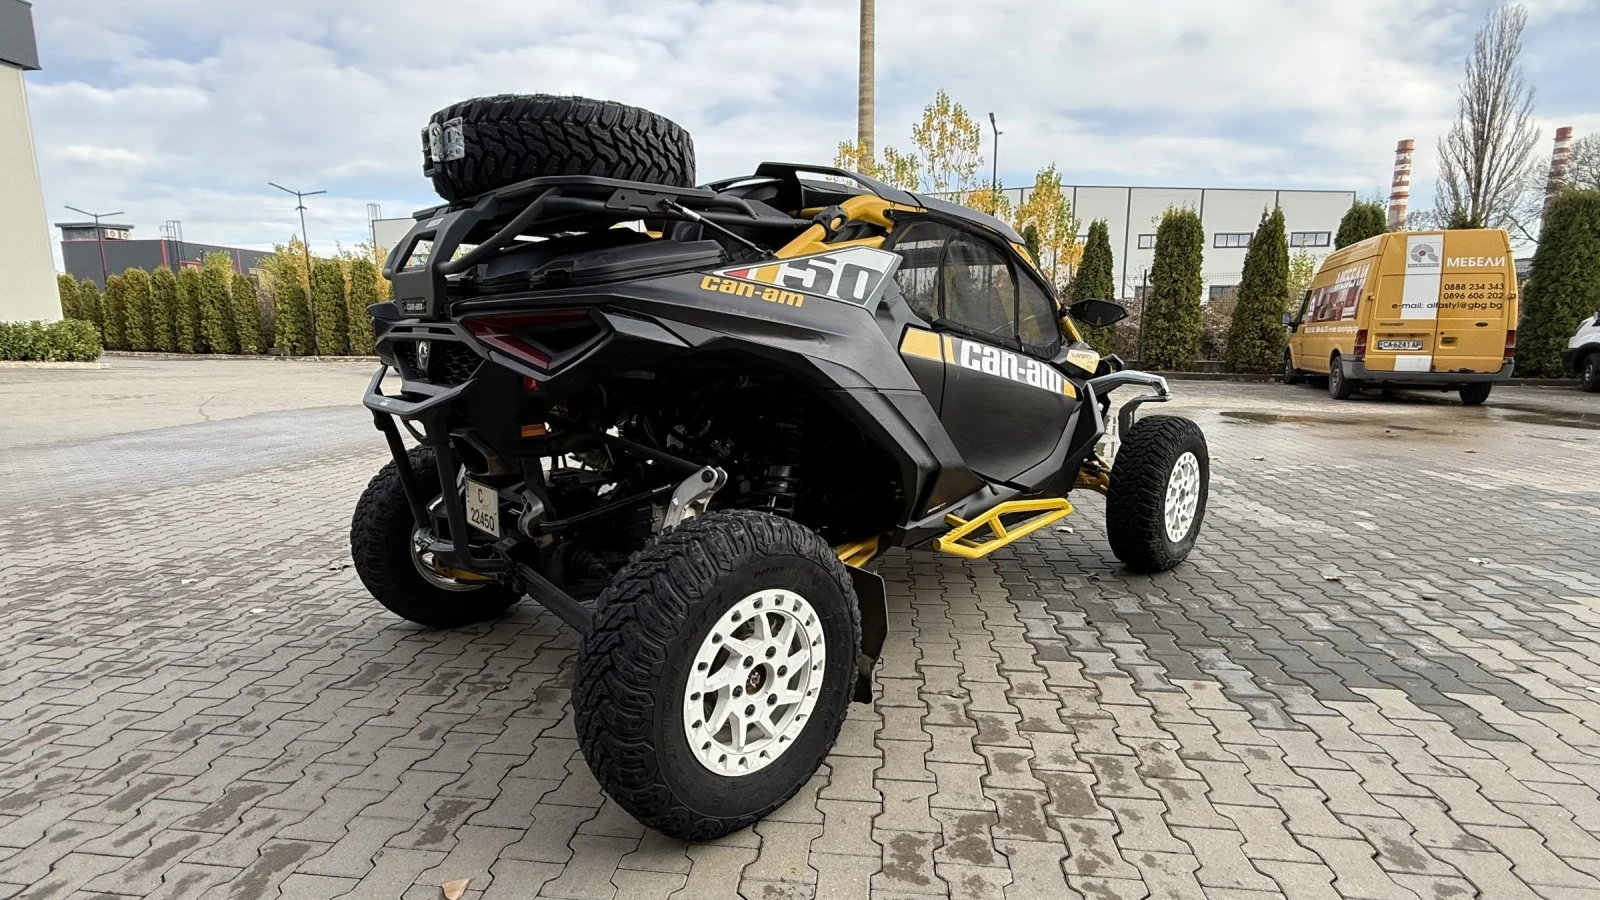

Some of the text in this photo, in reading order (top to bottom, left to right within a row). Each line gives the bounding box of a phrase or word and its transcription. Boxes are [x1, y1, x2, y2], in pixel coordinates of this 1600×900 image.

[1446, 256, 1505, 268] МЕБЕЛИ
[700, 275, 805, 308] can-am
[1444, 283, 1505, 291] 0888 234 343
[1443, 292, 1504, 300] 0896 606 202
[1391, 301, 1424, 309] e-mail:
[959, 340, 1063, 394] can-am
[477, 488, 484, 504] C
[470, 506, 495, 531] 22450
